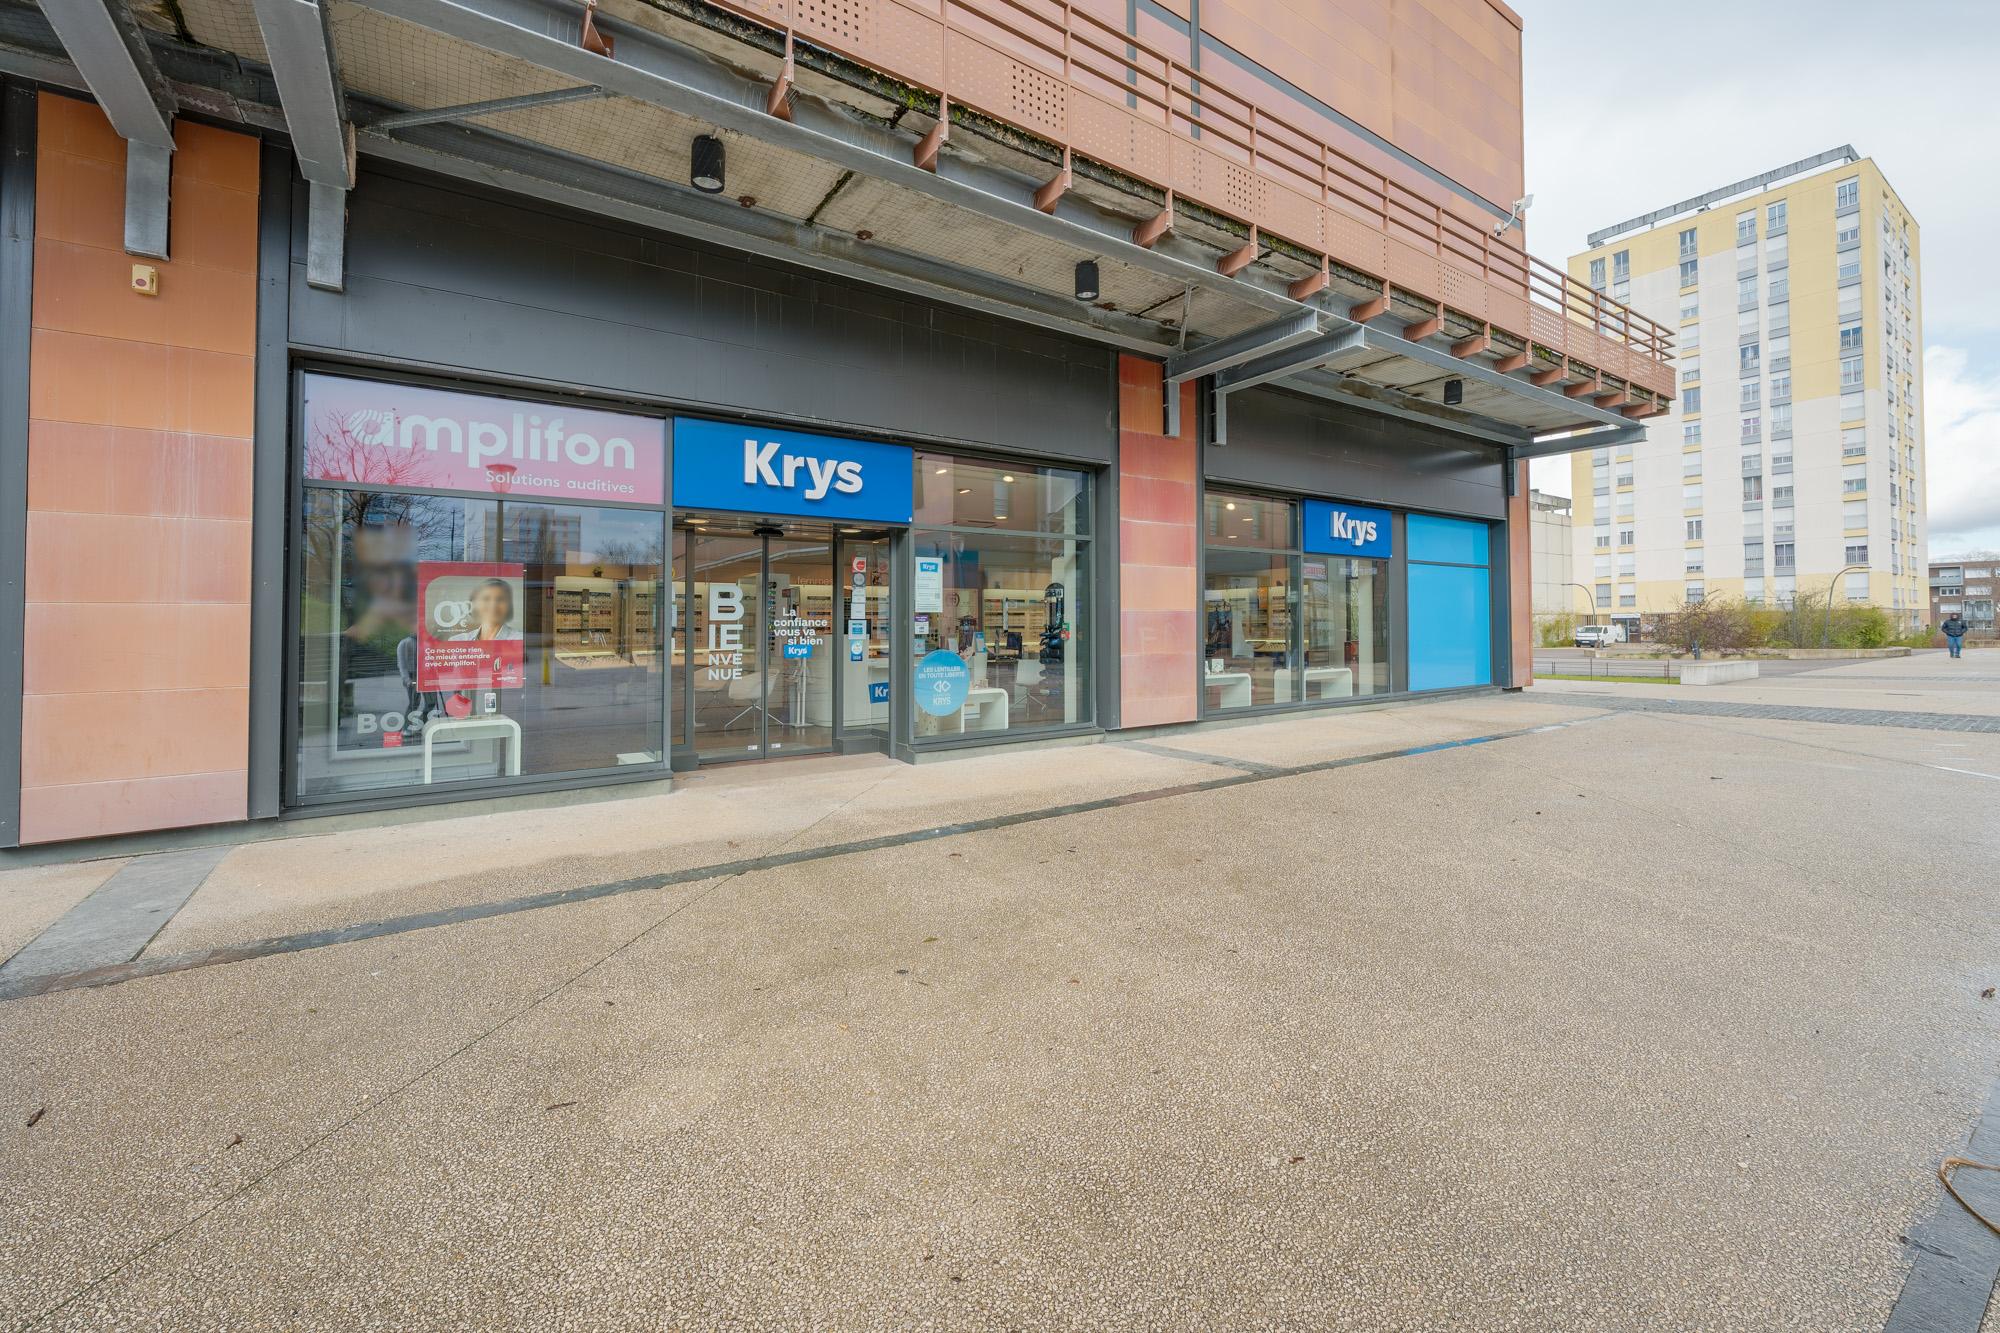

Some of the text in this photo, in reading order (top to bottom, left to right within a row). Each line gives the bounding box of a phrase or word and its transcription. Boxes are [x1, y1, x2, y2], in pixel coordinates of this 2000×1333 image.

[348, 410, 634, 469] amplifon
[743, 440, 863, 500] Krys
[485, 470, 634, 494] Solutions auditives
[1332, 511, 1377, 546] Krys
[782, 607, 796, 617] La
[773, 617, 828, 627] confiance
[802, 628, 816, 636] va
[787, 636, 798, 646] si
[788, 646, 808, 655] Krys
[443, 659, 477, 668] Amplifon.
[708, 653, 742, 665] NVE
[708, 668, 742, 680] NUE
[875, 687, 889, 698] Kr
